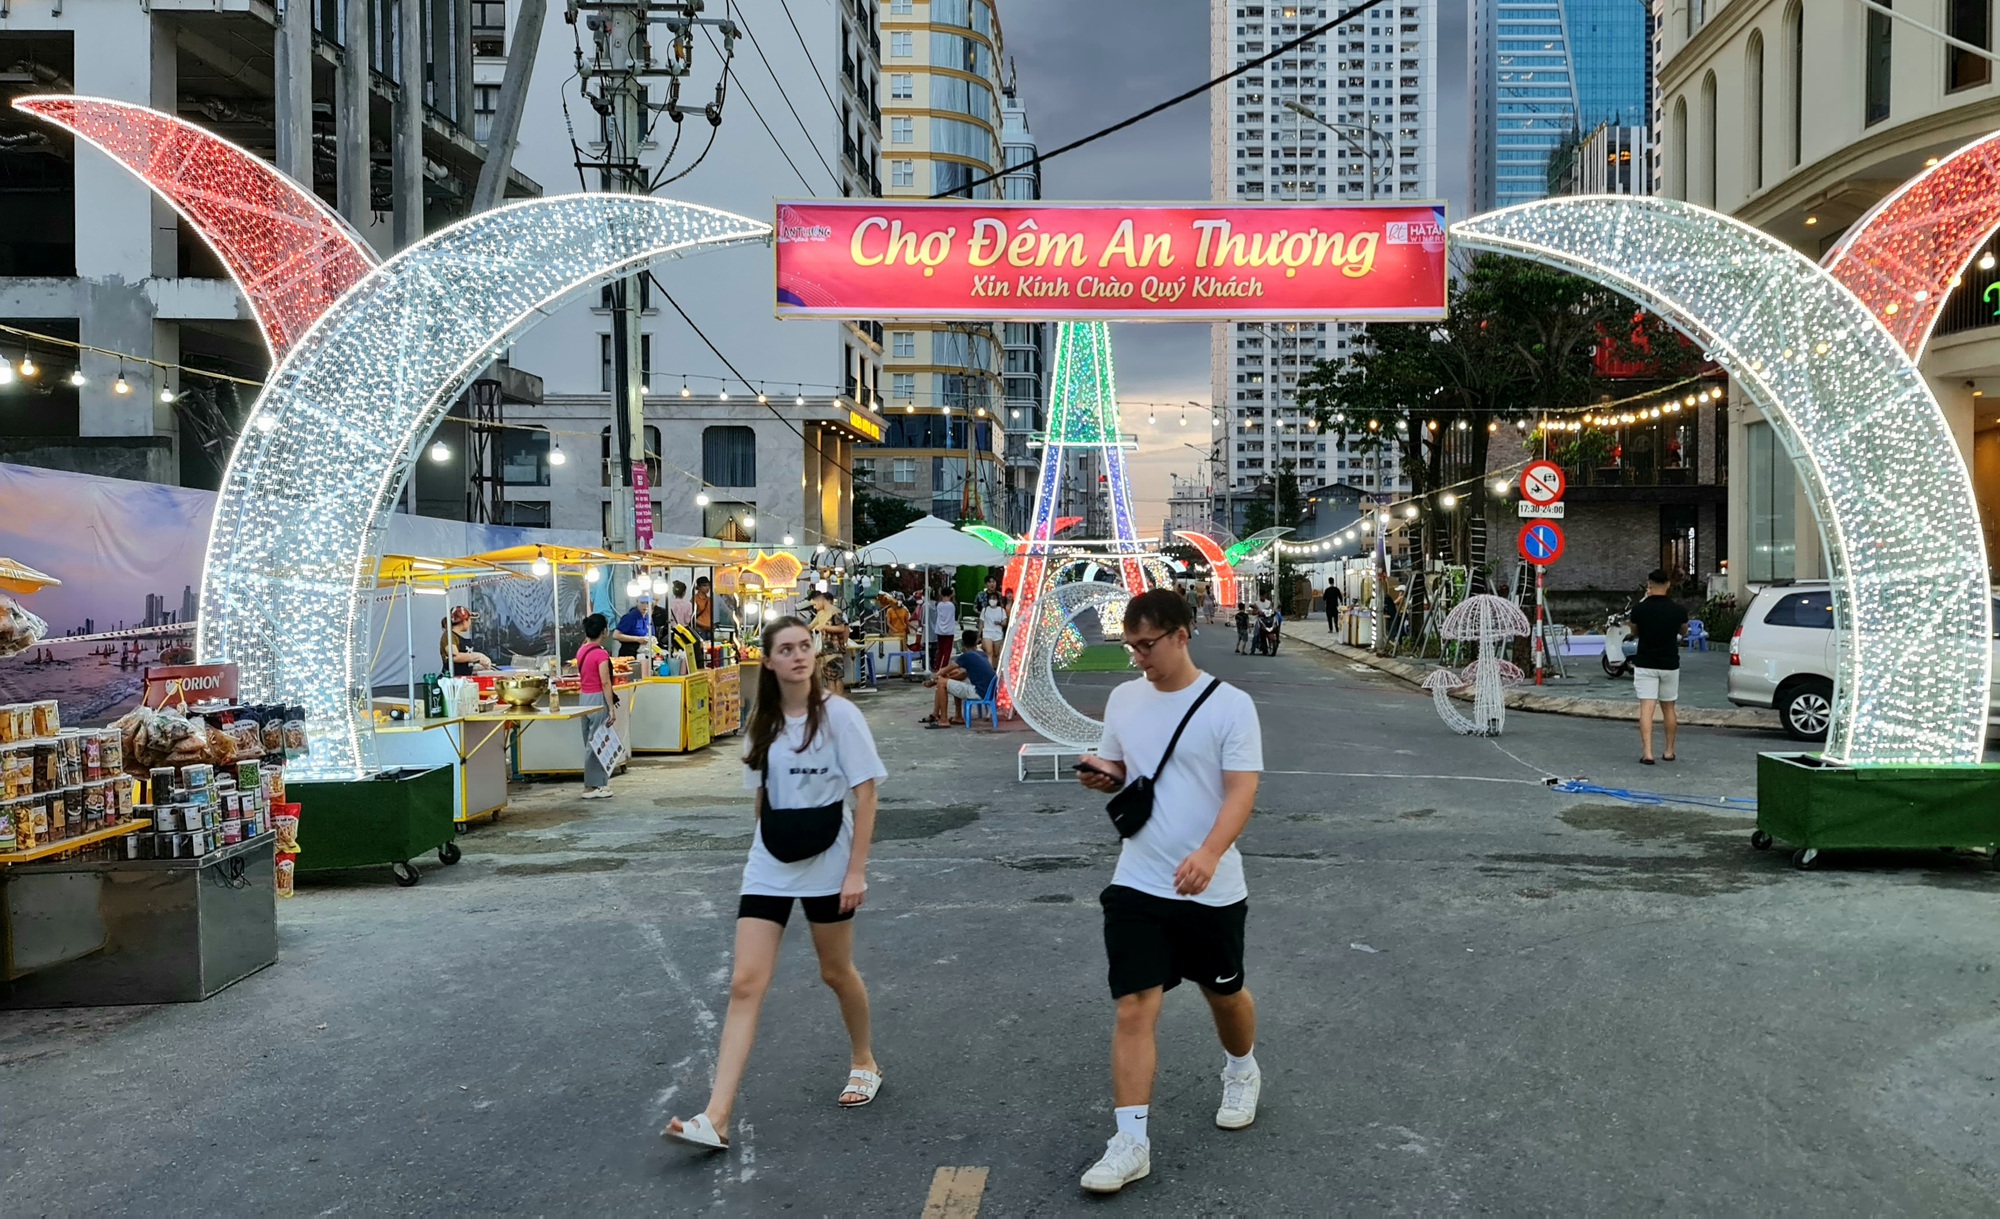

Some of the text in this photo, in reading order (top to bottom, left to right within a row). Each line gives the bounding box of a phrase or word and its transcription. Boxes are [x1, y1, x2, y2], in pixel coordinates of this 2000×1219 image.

[850, 216, 1380, 278] Chợ Đêm An Thượng
[971, 275, 1263, 303] Xin Kính Chào Quý Khách
[182, 676, 219, 691] ORION
